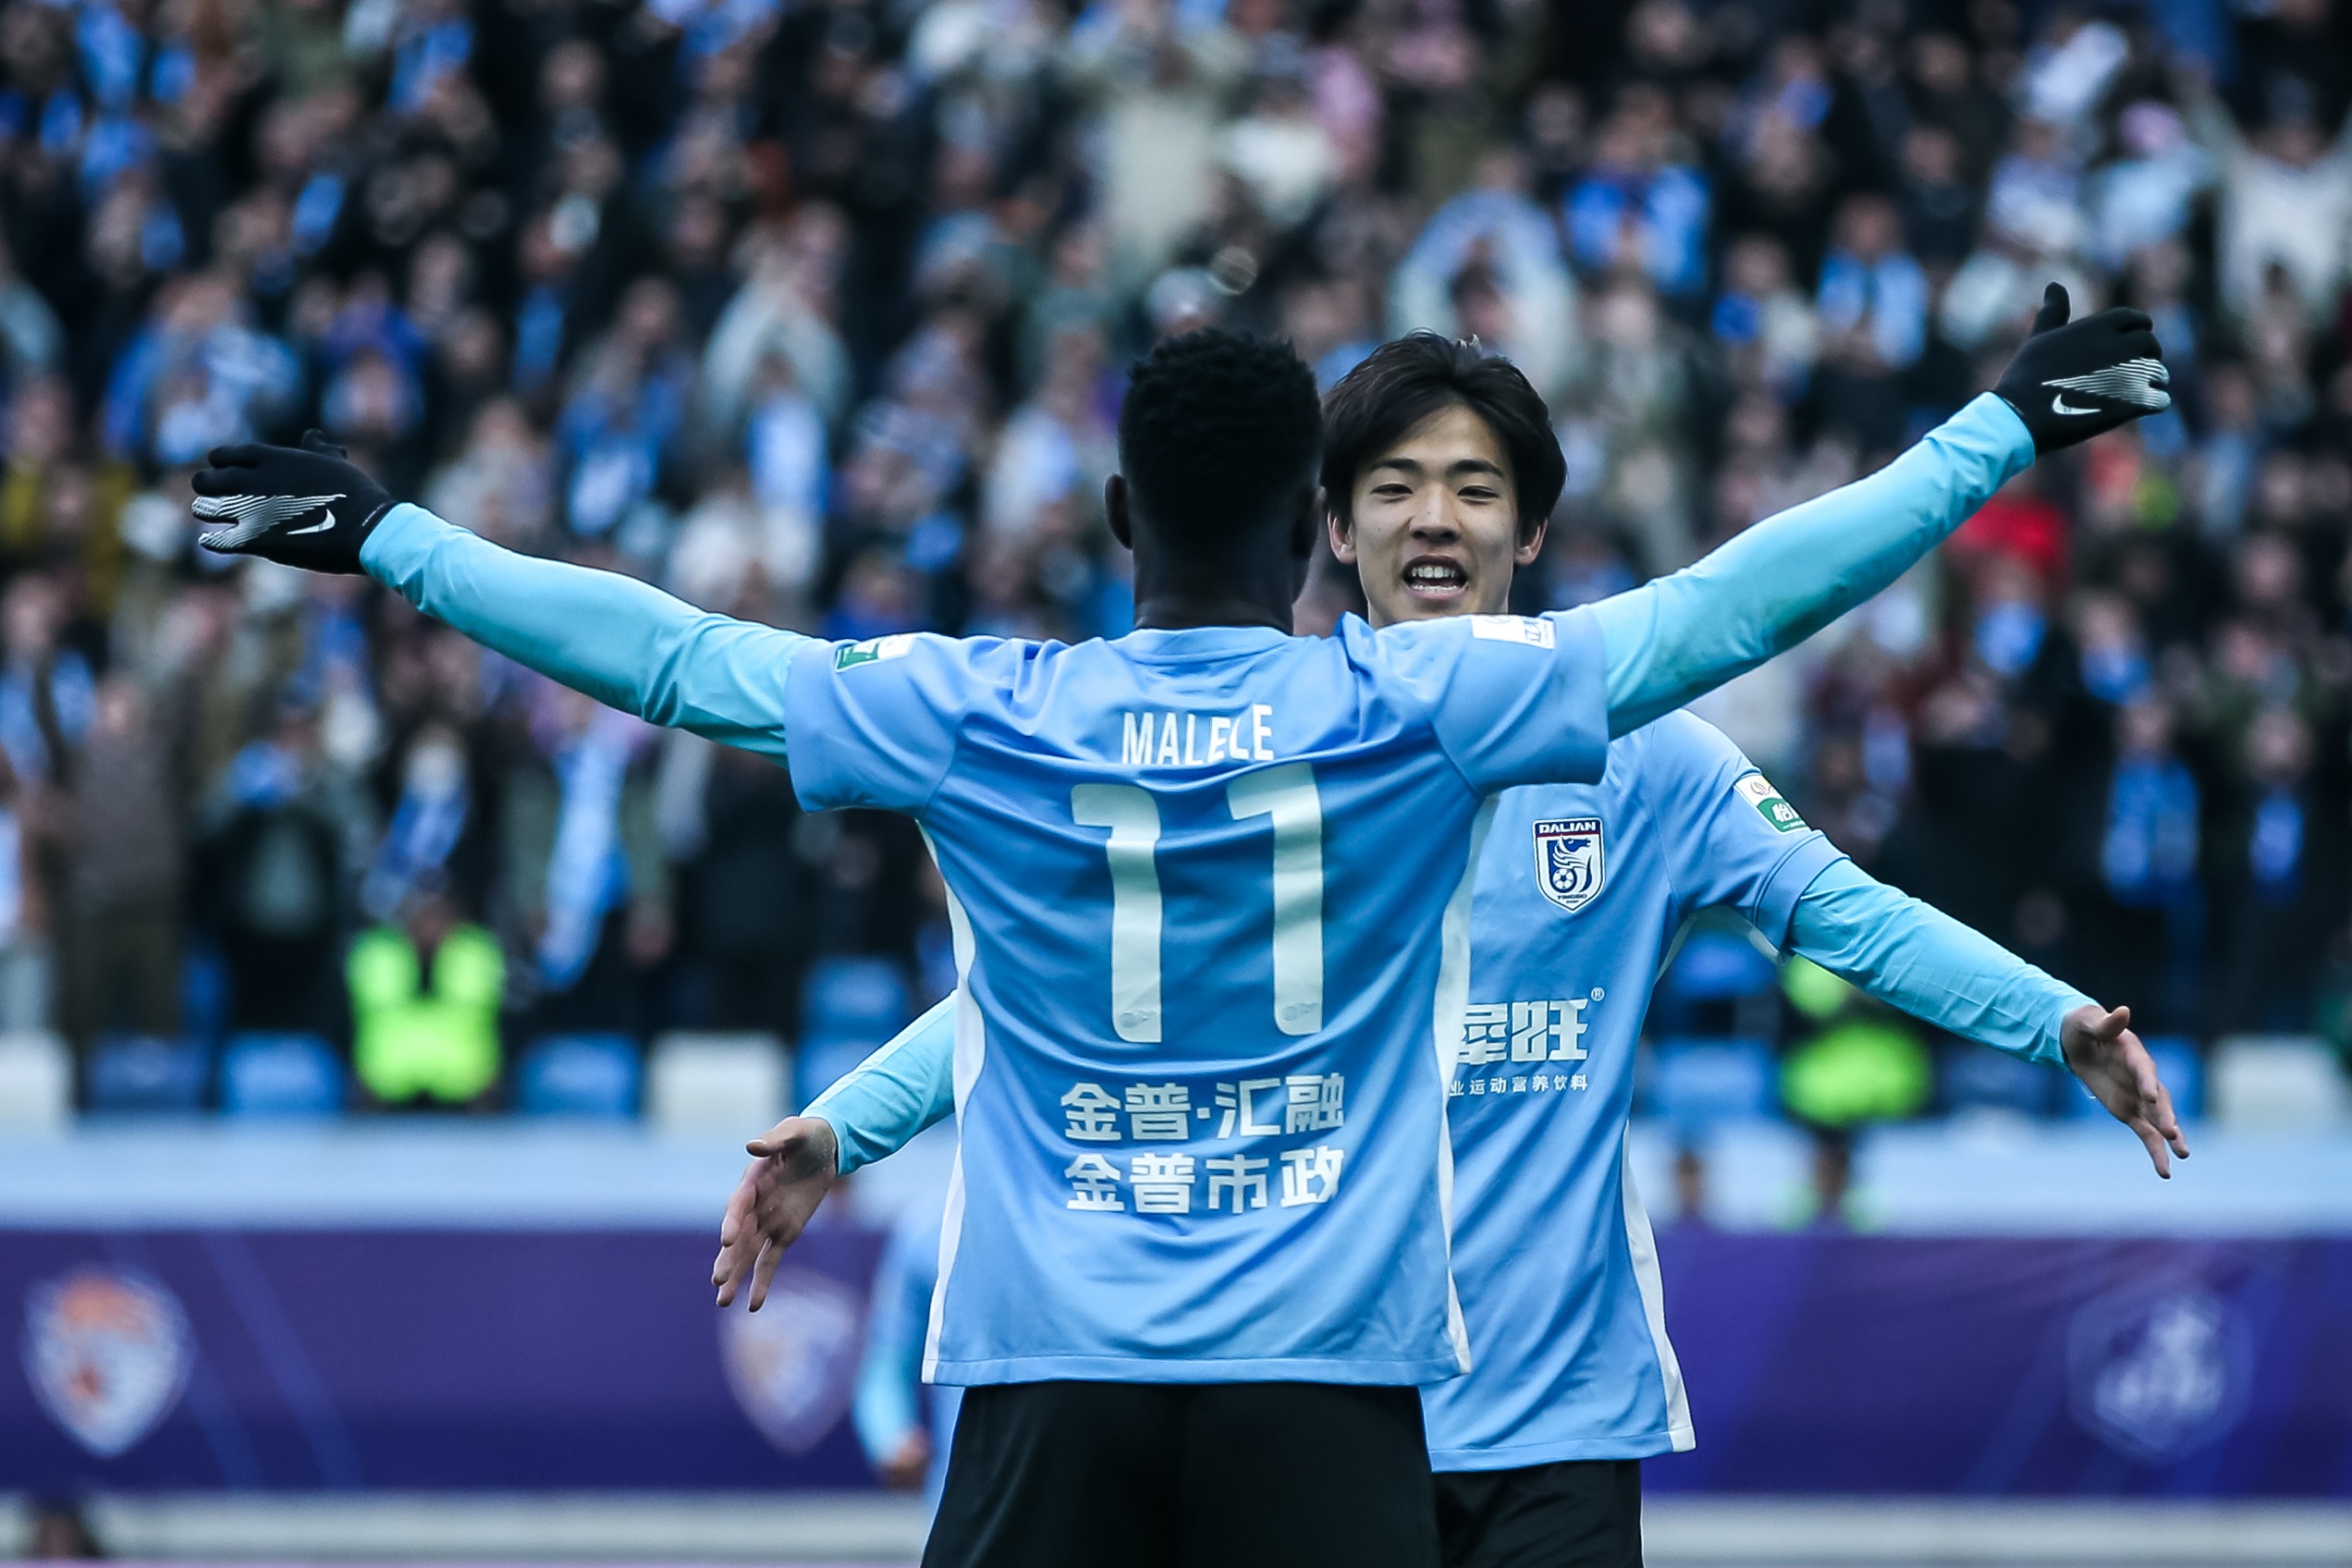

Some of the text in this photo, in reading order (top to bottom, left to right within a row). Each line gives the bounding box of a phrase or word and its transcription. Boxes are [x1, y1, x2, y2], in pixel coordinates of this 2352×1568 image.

[1538, 821, 1597, 834] DALIAN
[1071, 761, 1324, 1044] 11
[1064, 1145, 1345, 1215] 金普市政
